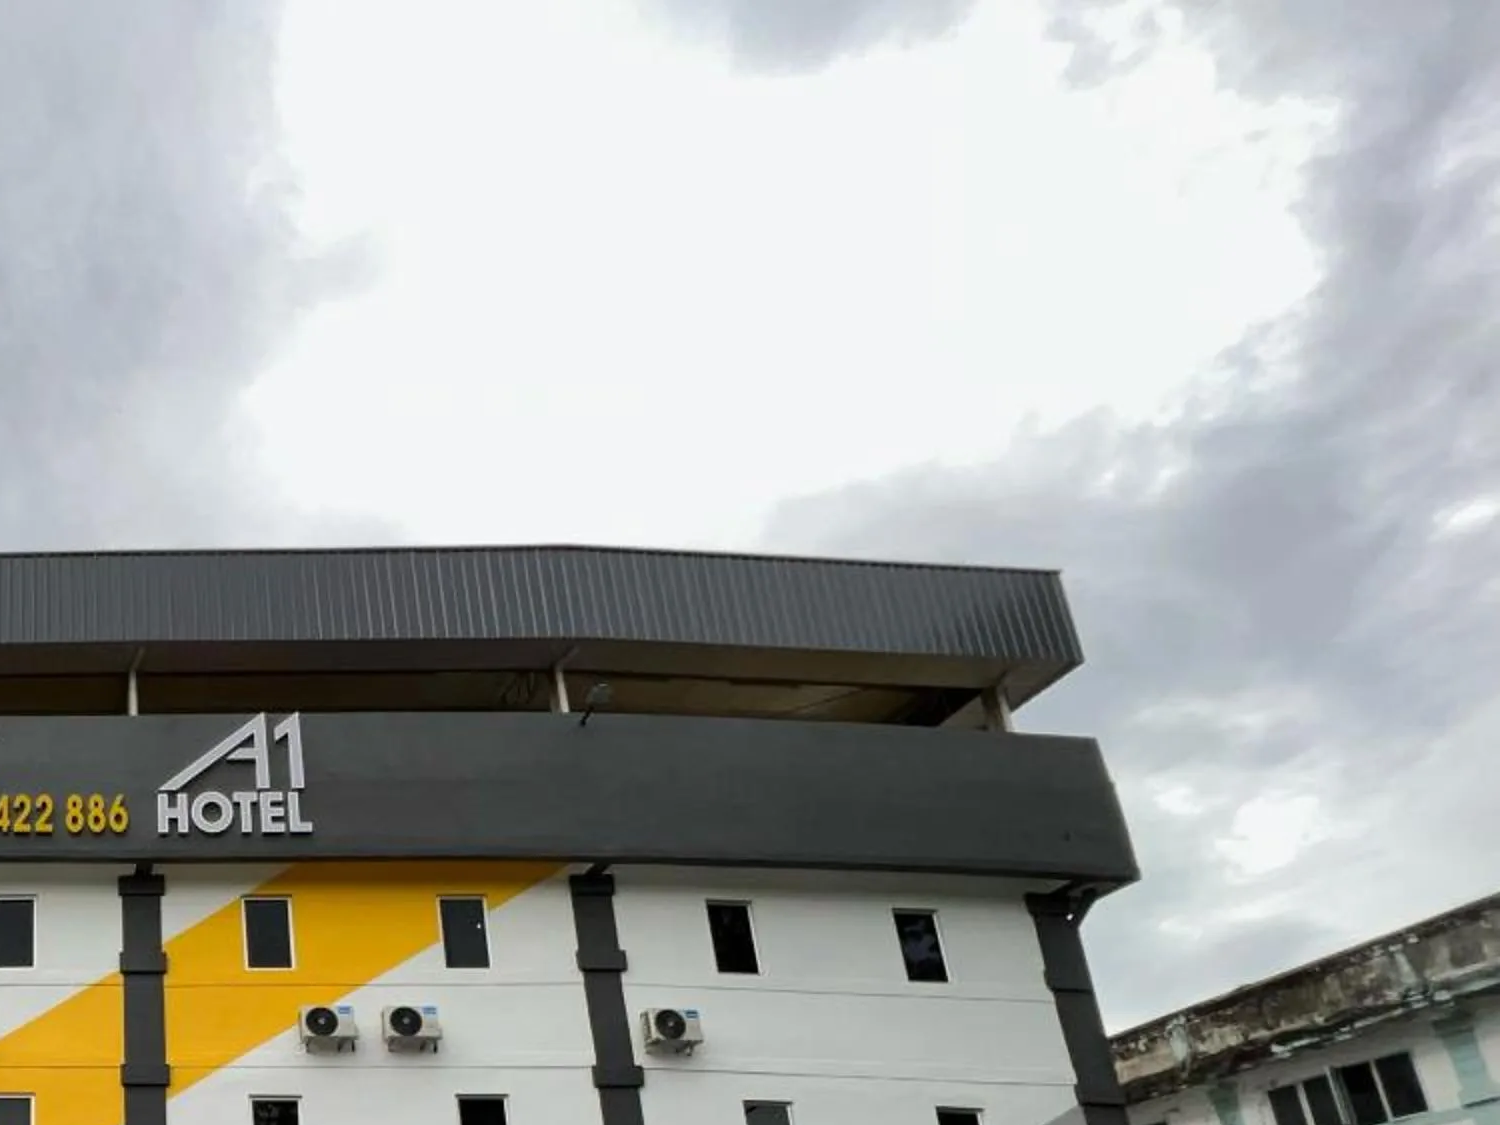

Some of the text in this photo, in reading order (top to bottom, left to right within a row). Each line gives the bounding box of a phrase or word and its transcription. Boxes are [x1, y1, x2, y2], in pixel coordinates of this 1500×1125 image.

[157, 712, 305, 791] A1
[66, 793, 129, 834] 886
[156, 791, 313, 834] HOTEL
